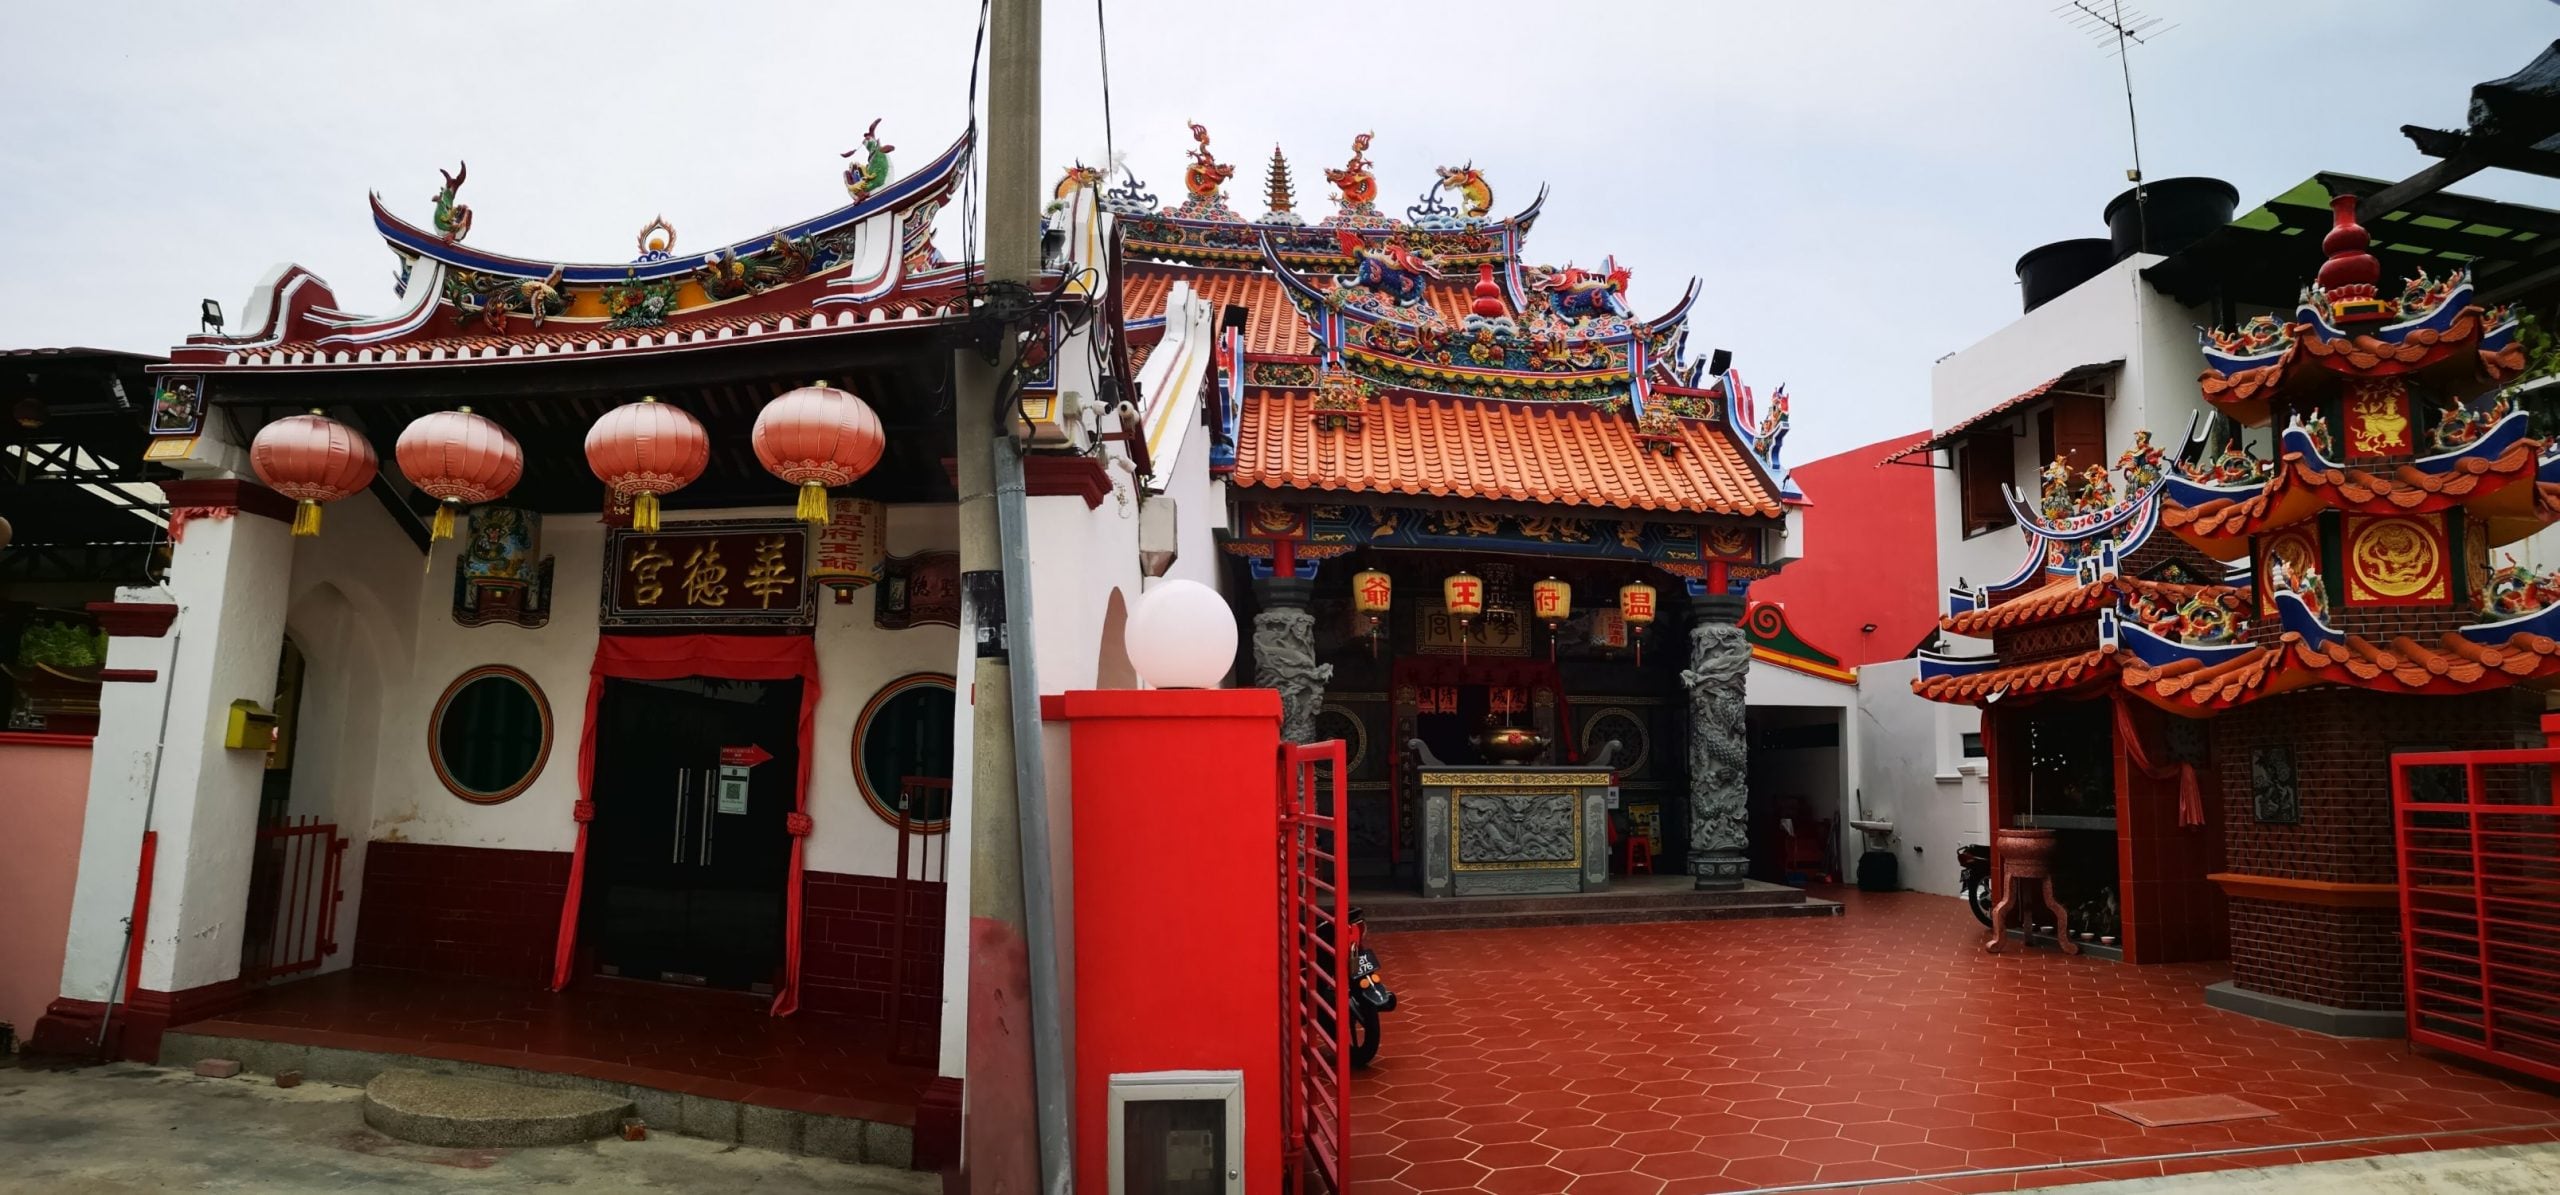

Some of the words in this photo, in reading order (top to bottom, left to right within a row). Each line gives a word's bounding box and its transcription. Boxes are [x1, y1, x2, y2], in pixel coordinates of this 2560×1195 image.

[1361, 578, 1390, 606] 爺
[1452, 582, 1480, 608] 王
[1534, 587, 1560, 611] 府
